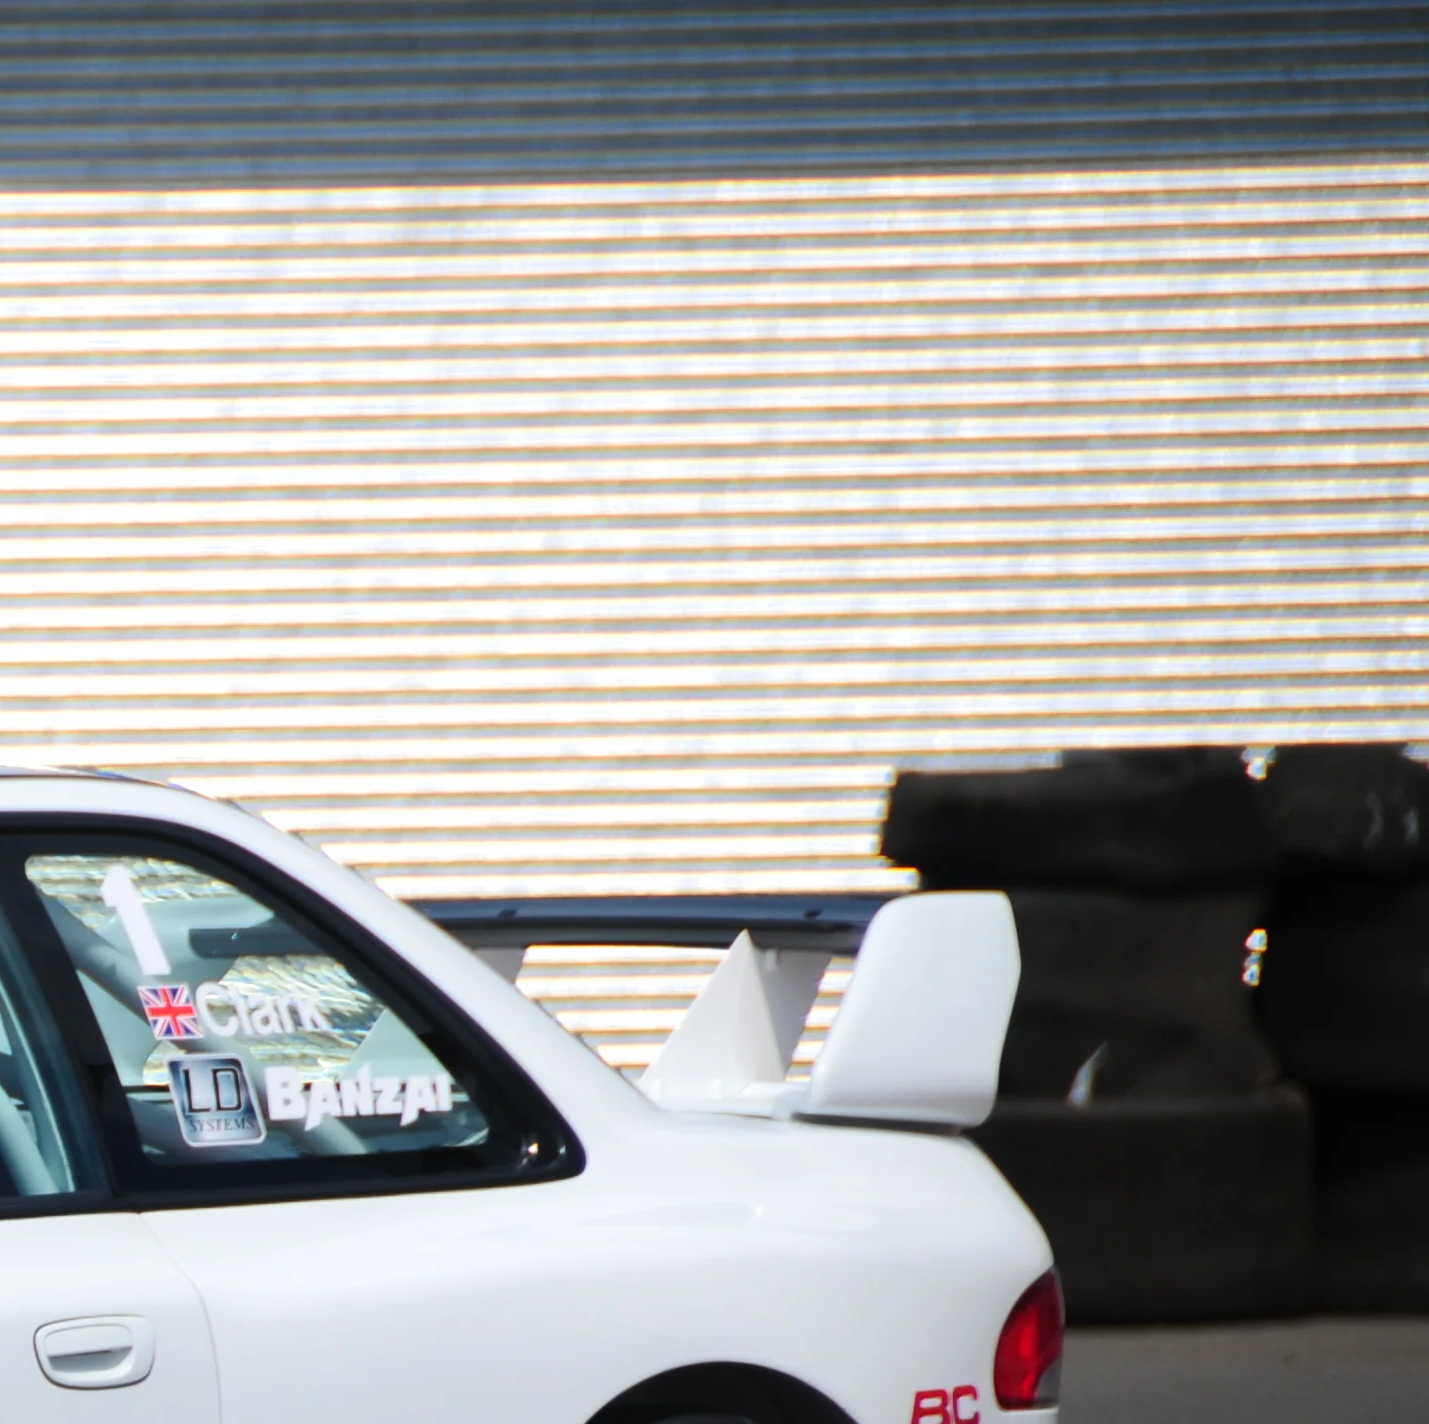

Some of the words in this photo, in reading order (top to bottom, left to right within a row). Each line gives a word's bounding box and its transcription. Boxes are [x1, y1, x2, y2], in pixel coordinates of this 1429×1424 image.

[99, 866, 172, 975] 1
[195, 981, 331, 1037] Clark
[183, 1067, 244, 1113] LD
[189, 1117, 256, 1133] SYSTEMS
